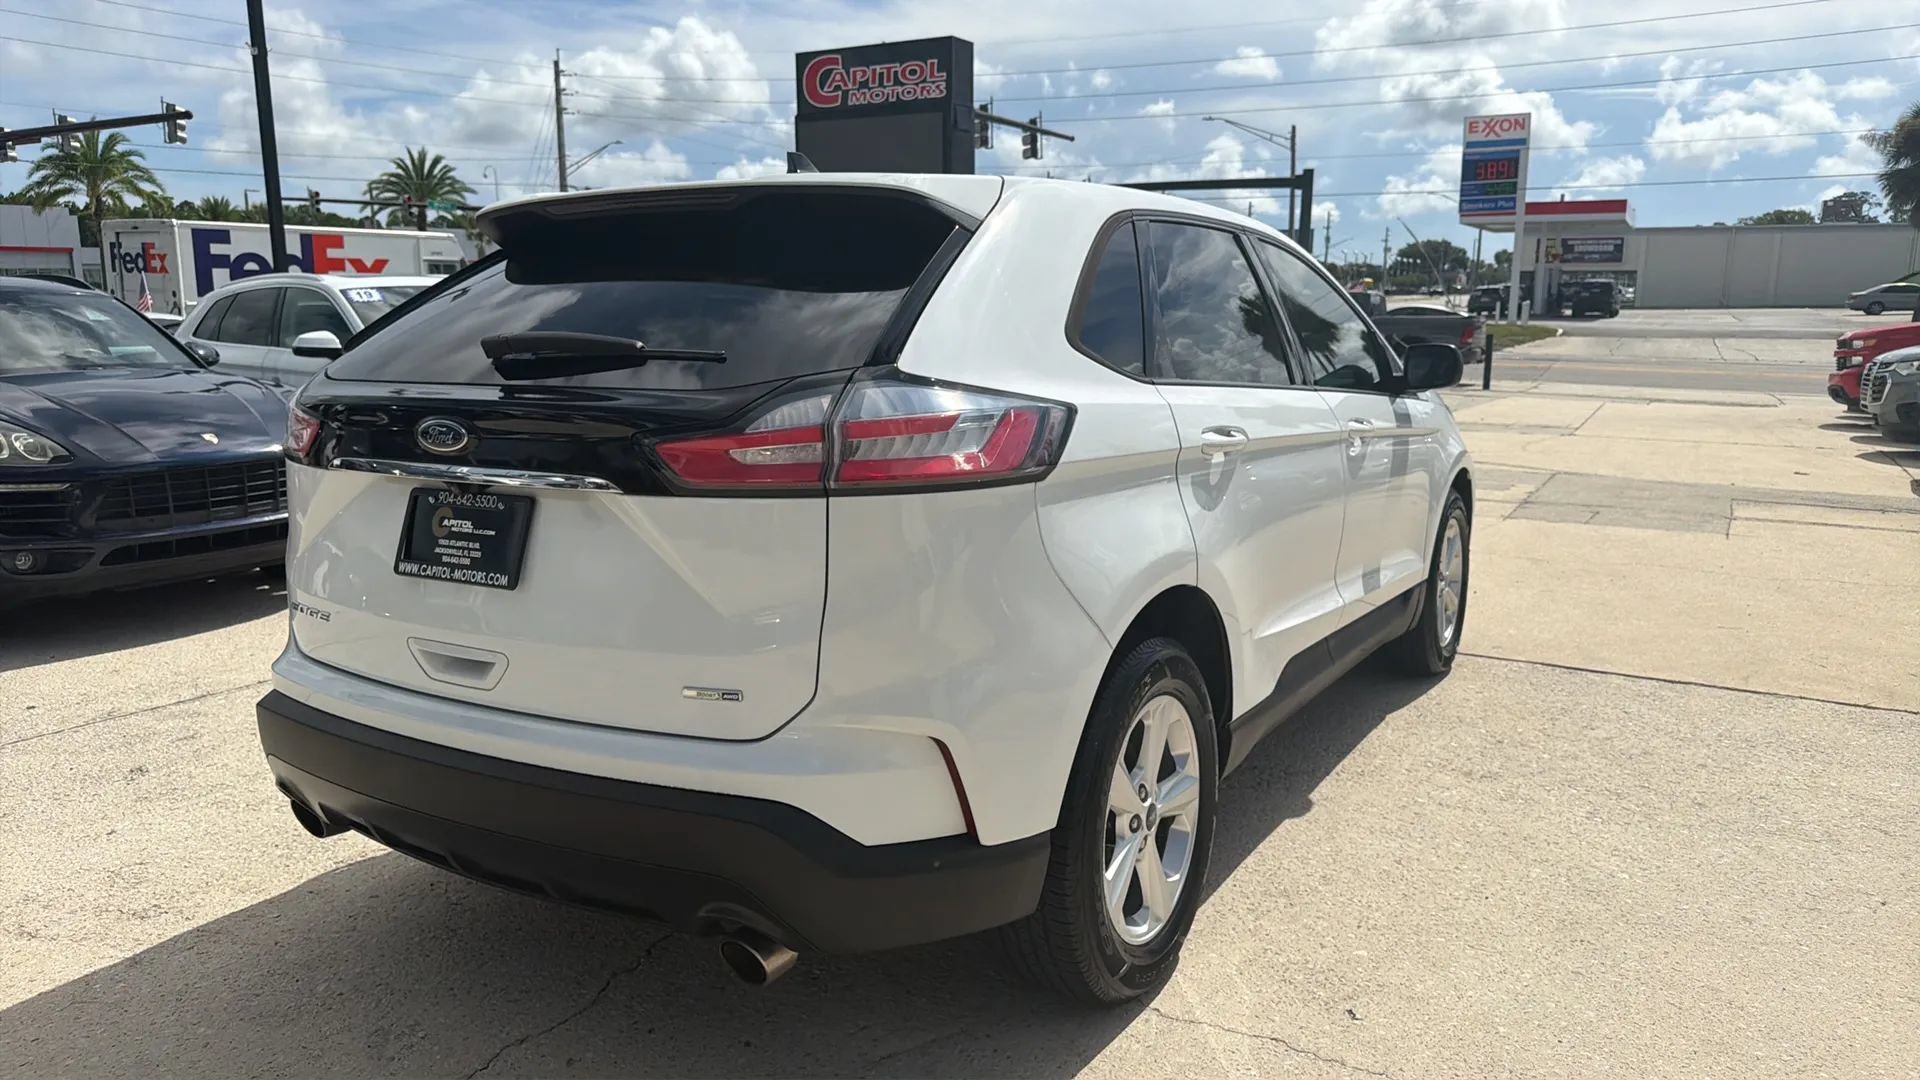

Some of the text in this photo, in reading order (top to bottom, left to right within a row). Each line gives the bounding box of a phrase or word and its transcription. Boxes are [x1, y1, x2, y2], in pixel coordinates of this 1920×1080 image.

[803, 54, 946, 108] CAPITOL
[848, 81, 946, 105] MOTORS
[1468, 117, 1526, 138] EXXON
[109, 241, 170, 274] FedEx
[426, 425, 454, 444] Ford
[438, 491, 498, 509] 904-642-5500
[398, 561, 508, 586] WWW.CAPITOL-MOTORS.COM
